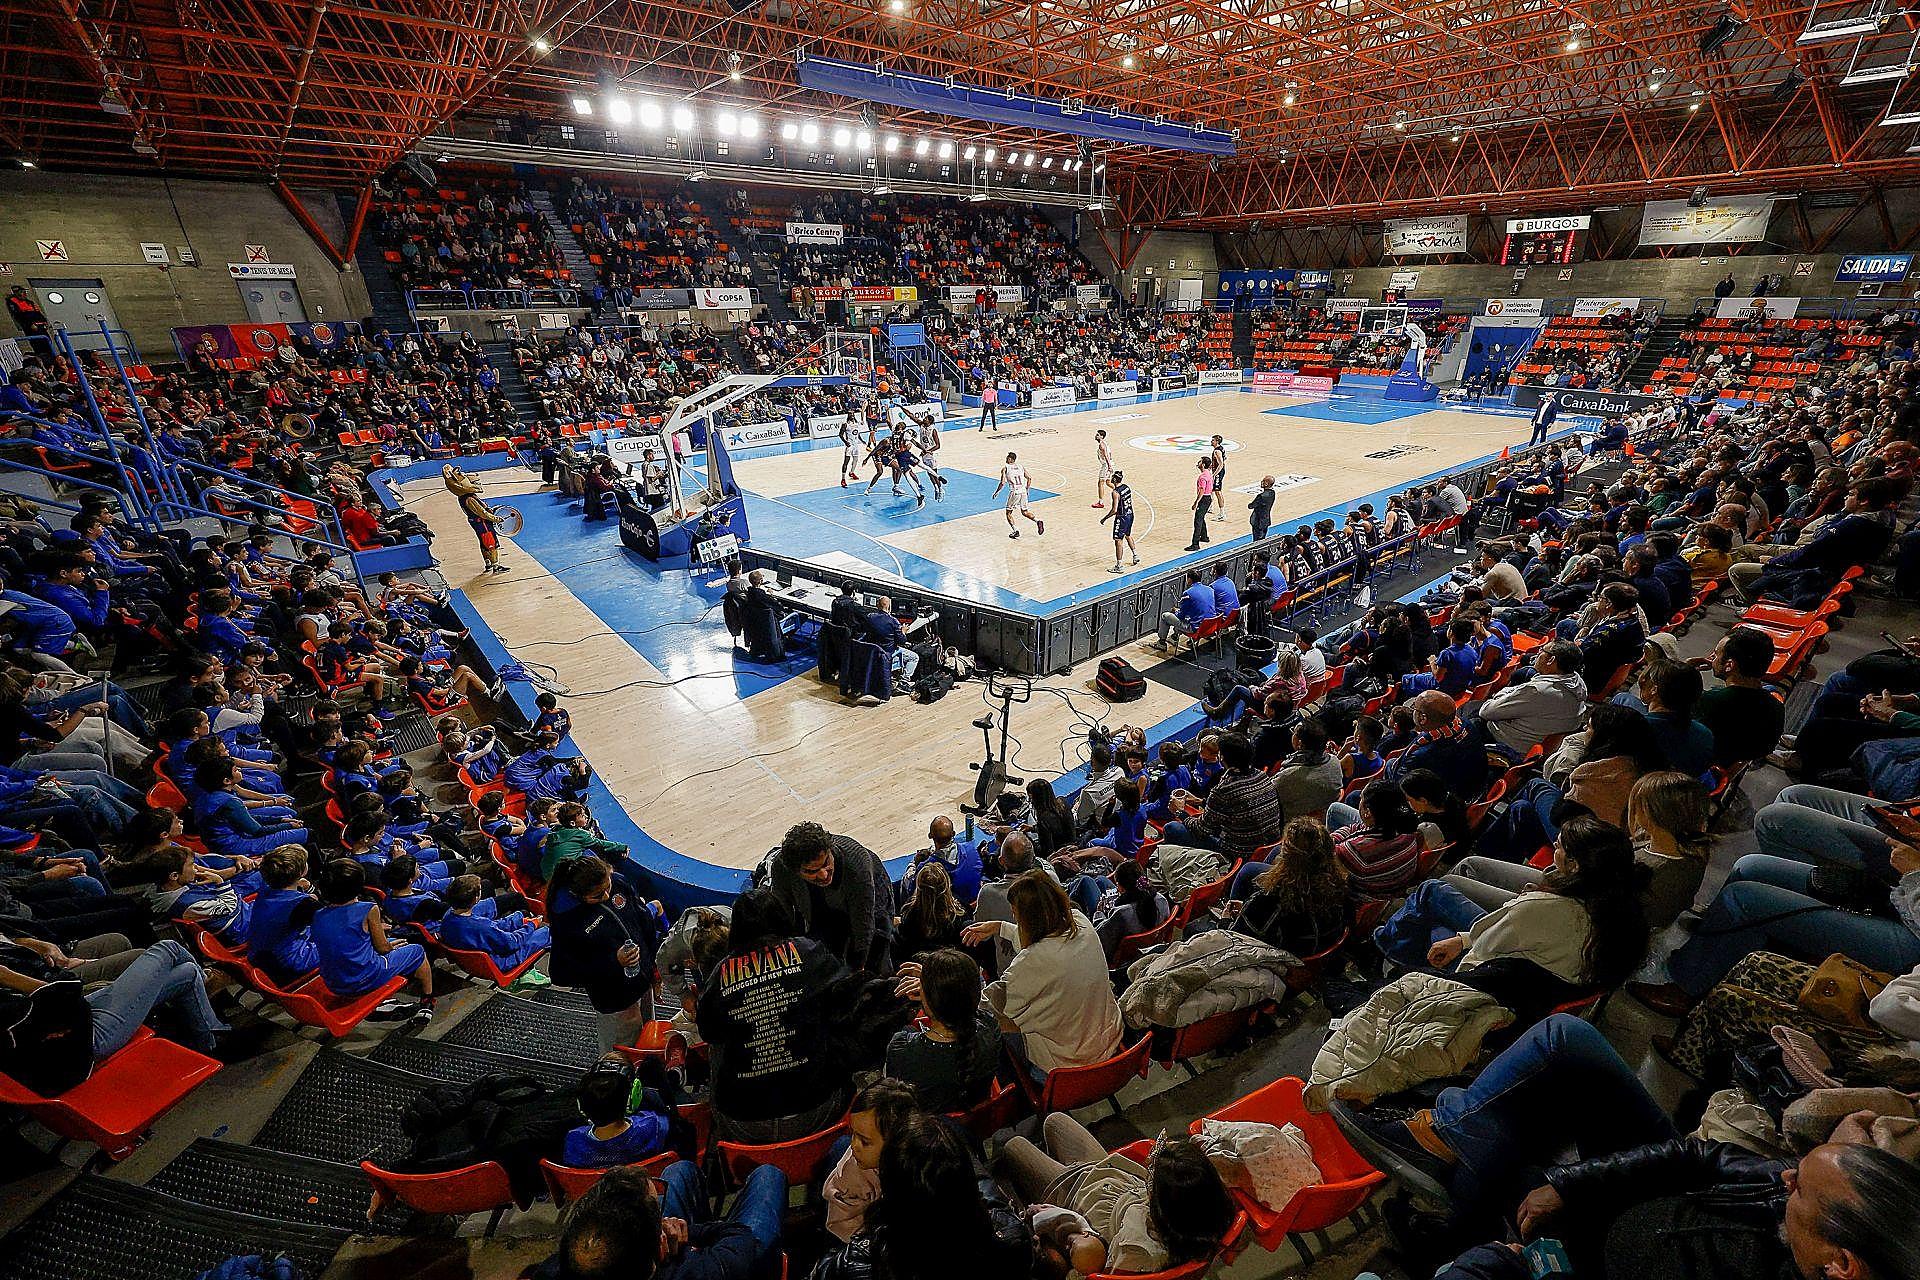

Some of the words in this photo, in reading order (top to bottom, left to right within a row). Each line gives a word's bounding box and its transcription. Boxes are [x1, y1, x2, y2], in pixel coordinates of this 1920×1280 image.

[794, 226, 814, 235] Brico
[815, 227, 841, 236] Centro
[1526, 218, 1579, 231] BURGOS
[1524, 246, 1534, 254] 20
[250, 267, 268, 275] TENIS
[268, 267, 277, 275] DE
[278, 268, 295, 276] MESA
[1841, 259, 1891, 274] SALIDA
[718, 294, 744, 302] COPSA
[1559, 393, 1632, 414] CaixaBank
[744, 426, 787, 442] CaixaBank
[614, 440, 659, 452] GrupoU
[719, 941, 803, 991] NIRVANA
[721, 976, 759, 998] UNPLUGGED
[759, 975, 767, 983] IN
[767, 970, 783, 981] NEW
[783, 965, 802, 976] YORK
